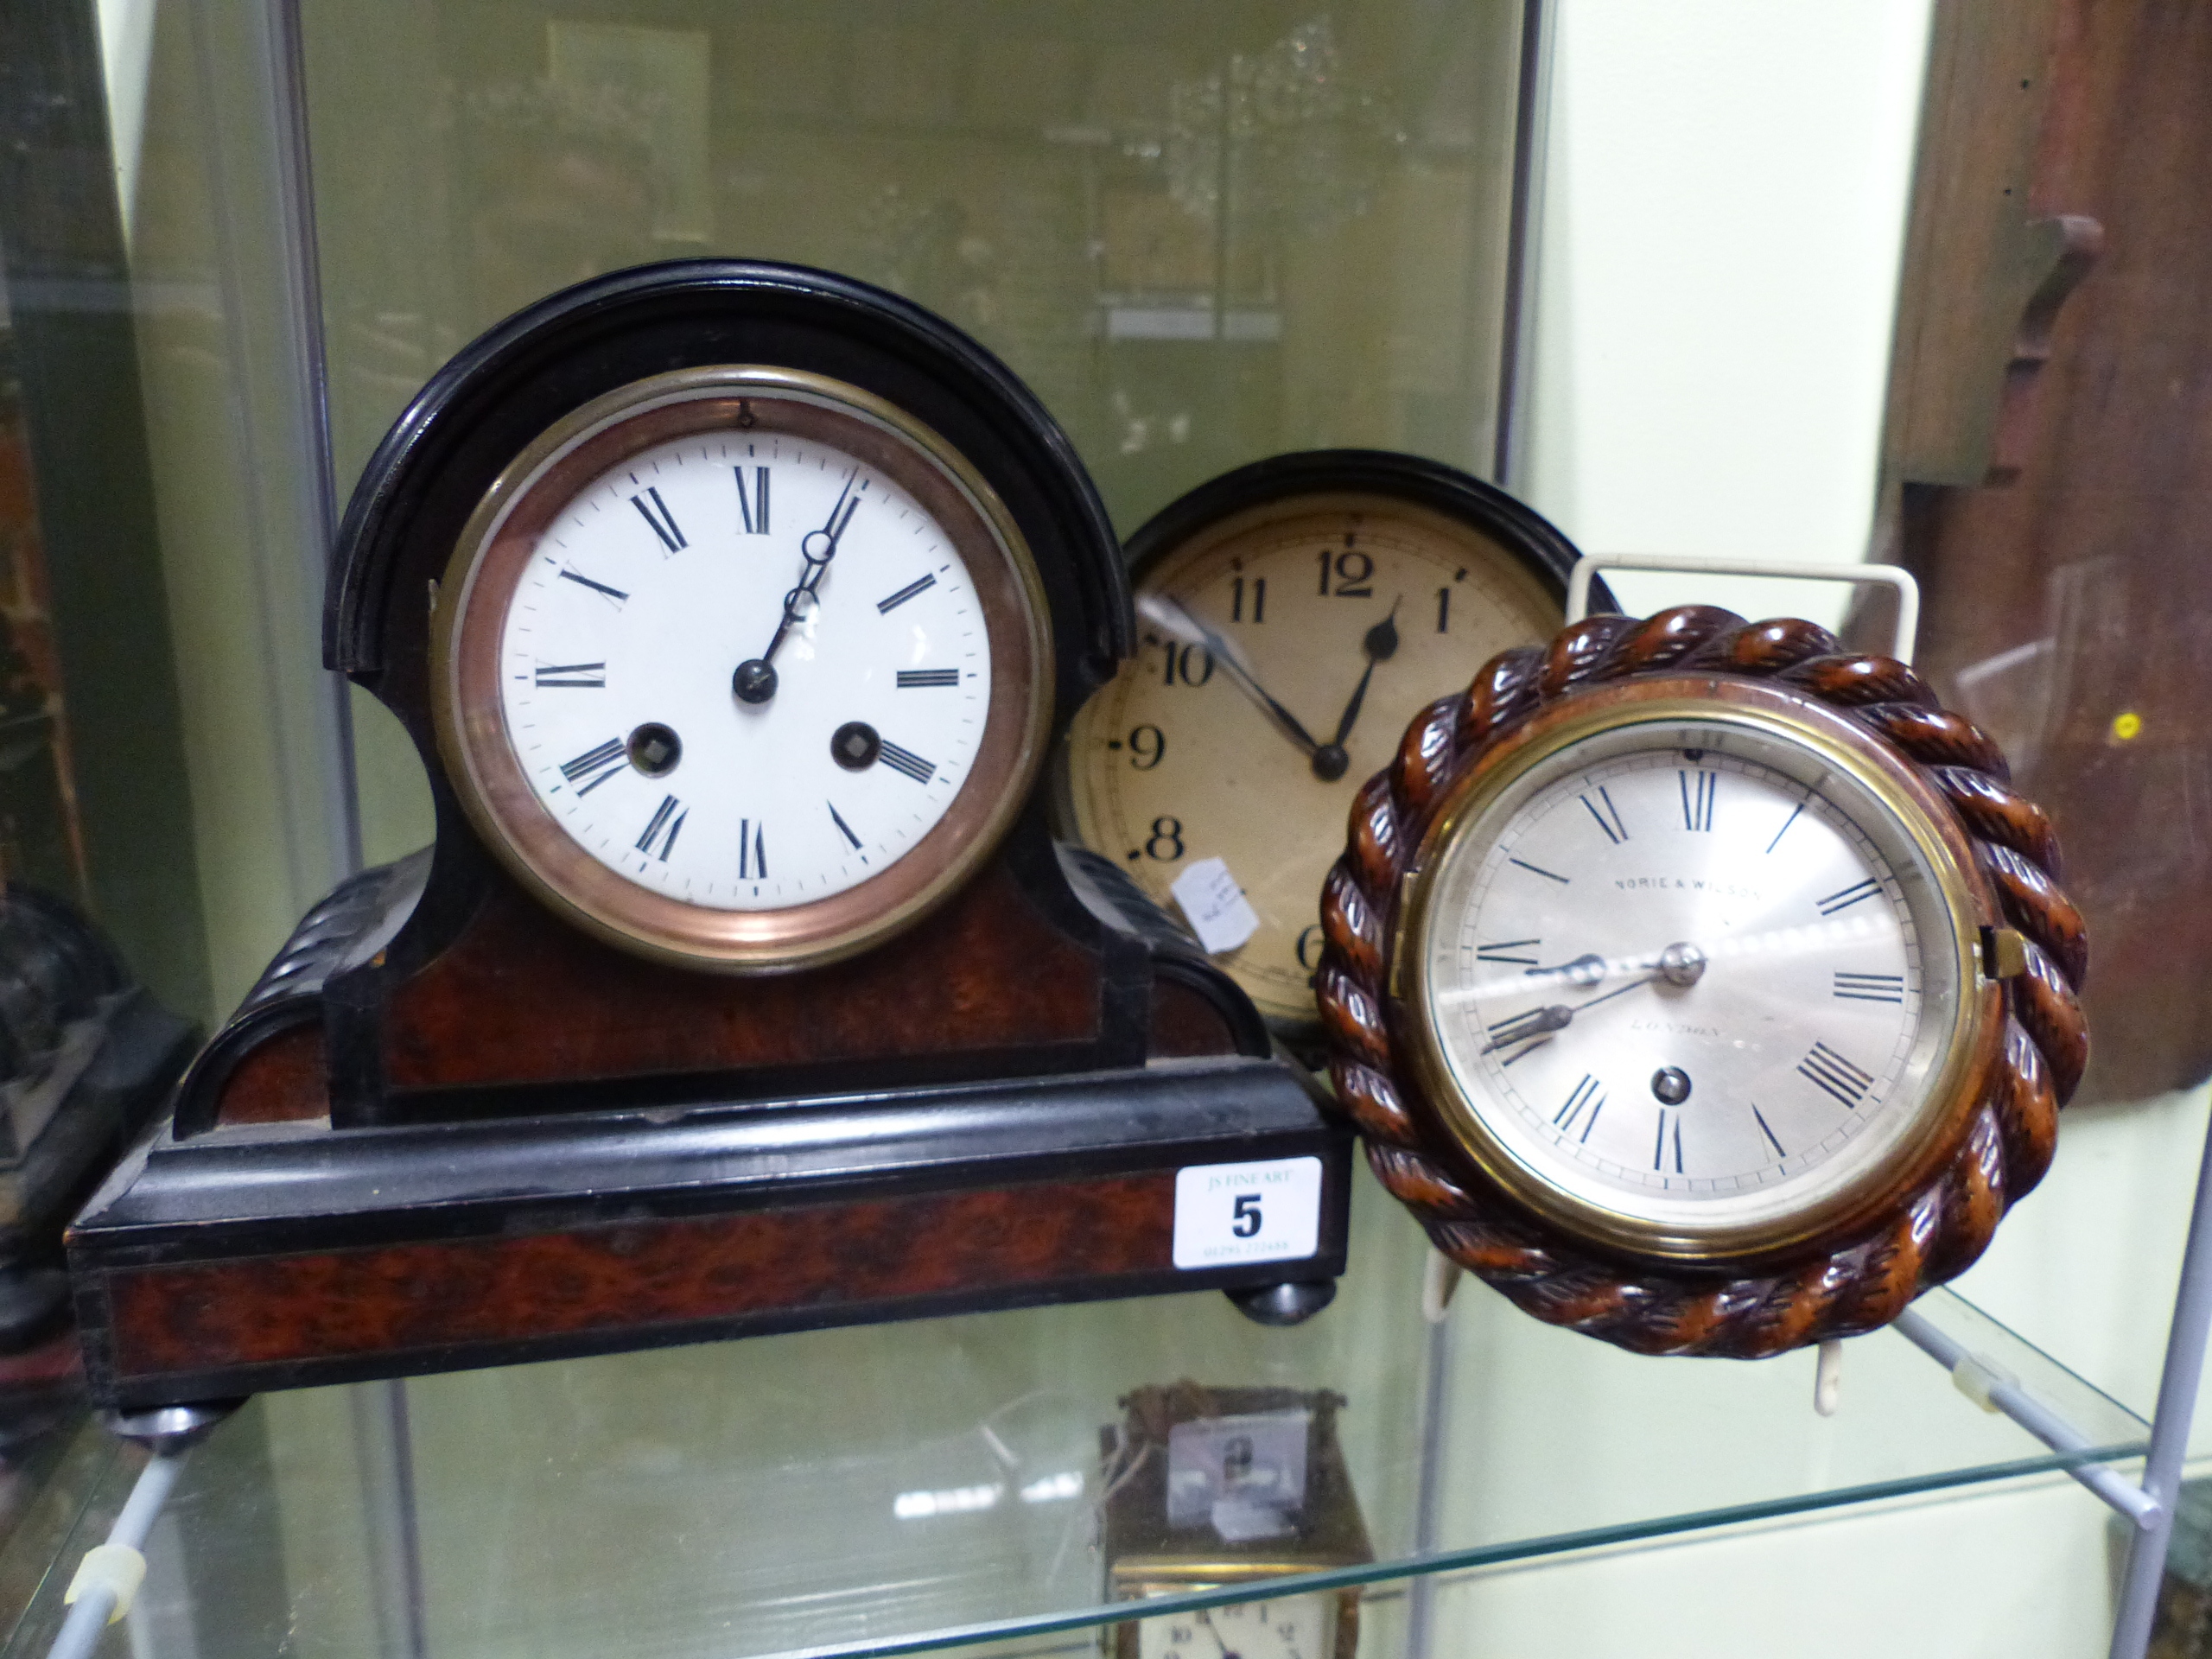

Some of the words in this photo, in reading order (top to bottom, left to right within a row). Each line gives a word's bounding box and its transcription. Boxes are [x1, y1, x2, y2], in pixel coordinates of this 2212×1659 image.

[629, 486, 690, 558] XI
[734, 466, 770, 535] XII
[558, 561, 630, 612] X
[877, 572, 938, 615] II
[1317, 550, 1374, 597] 12
[1230, 576, 1267, 623] 11
[1435, 587, 1451, 633] 1
[535, 659, 606, 689] IX
[896, 669, 960, 689] III
[1162, 641, 1213, 689] 10
[1129, 724, 1166, 770] 9
[1579, 785, 1630, 845] XI
[1678, 770, 1716, 832] XII
[635, 793, 690, 863] VII
[739, 818, 768, 880] VI
[827, 798, 863, 856] V
[1146, 816, 1185, 862] 8
[1615, 876, 1668, 889] NORIE
[1816, 877, 1885, 917] II
[1833, 971, 1903, 1003] III
[1654, 1108, 1684, 1173] VI
[1225, 1173, 1258, 1186] FINE
[1262, 1169, 1293, 1184] ART
[1232, 1192, 1262, 1237] 5
